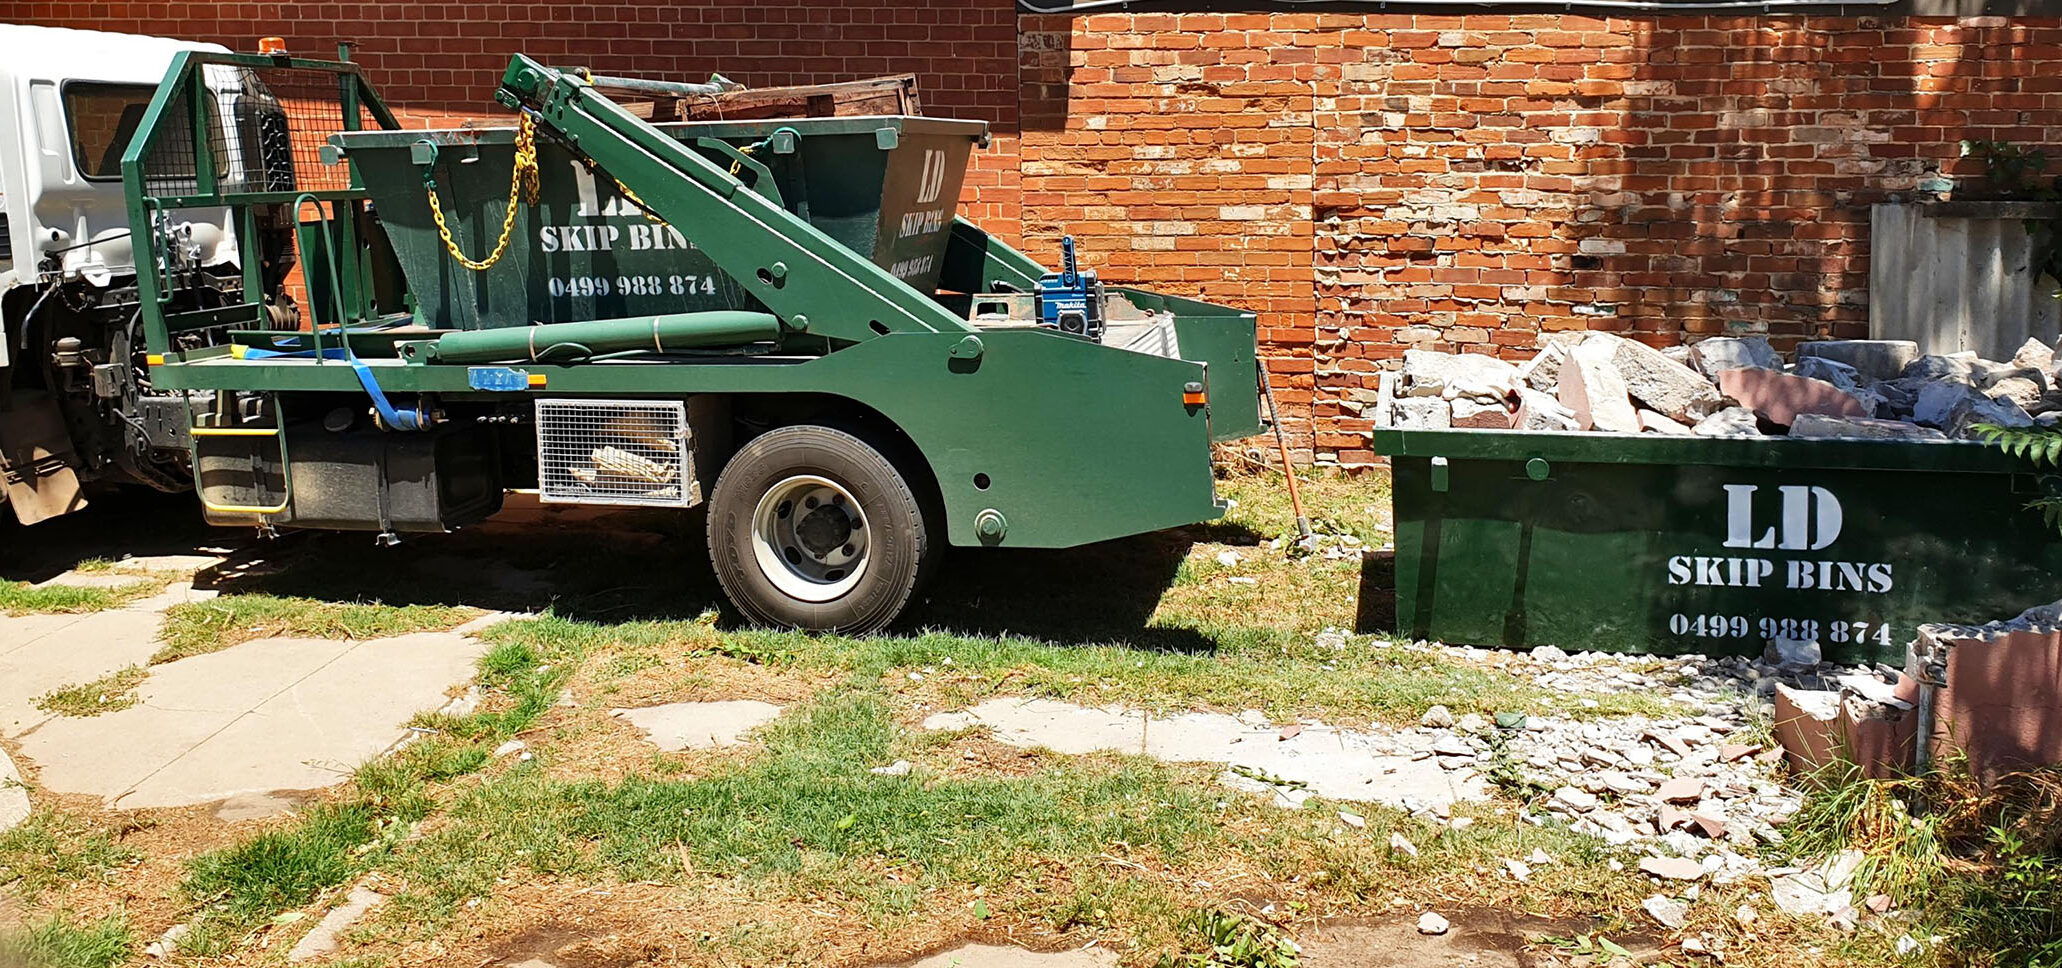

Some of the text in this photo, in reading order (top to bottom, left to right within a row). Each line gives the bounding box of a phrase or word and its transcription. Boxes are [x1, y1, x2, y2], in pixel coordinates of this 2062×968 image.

[917, 149, 945, 203] LD
[540, 224, 697, 252] SKIP BIN
[899, 212, 925, 238] SKIP
[548, 275, 716, 297] 0499 988 874
[1722, 484, 1843, 550] LD
[1668, 556, 1893, 593] SKIP BINS
[1669, 613, 1892, 646] 0499 988 874
